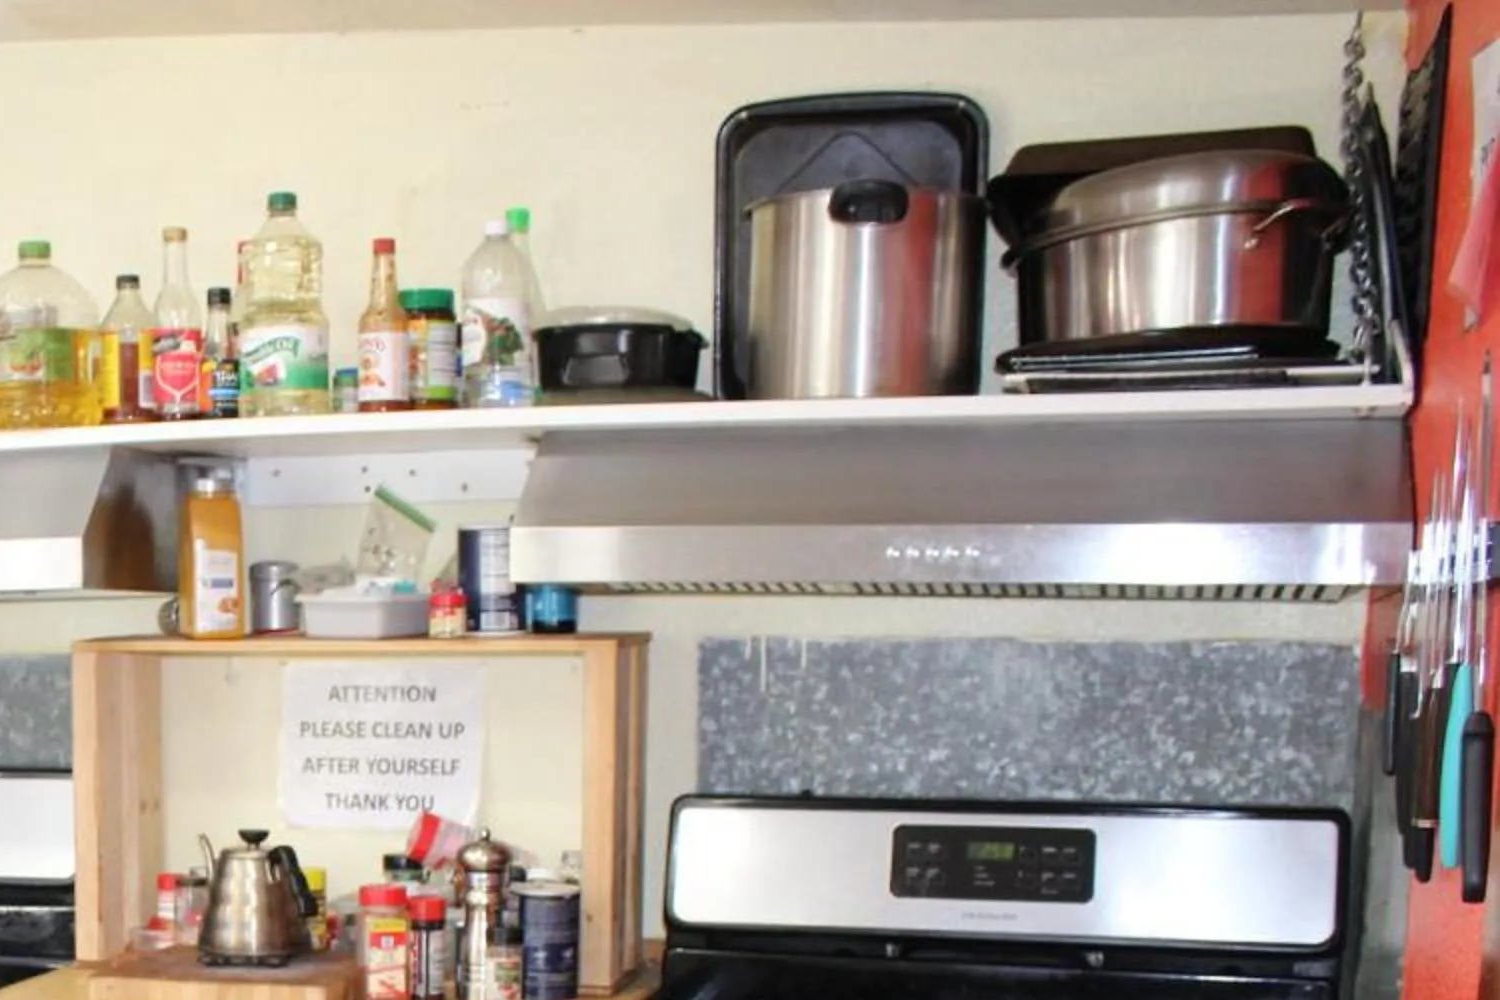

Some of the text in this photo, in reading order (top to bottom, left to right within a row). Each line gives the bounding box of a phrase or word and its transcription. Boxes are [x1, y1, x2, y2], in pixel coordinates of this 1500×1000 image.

[328, 684, 437, 702] ATTENTION
[300, 721, 465, 739] PLEASE CLEAN UP
[302, 757, 461, 776] AFTER YOURSELF
[325, 792, 435, 812] THANK YOU
